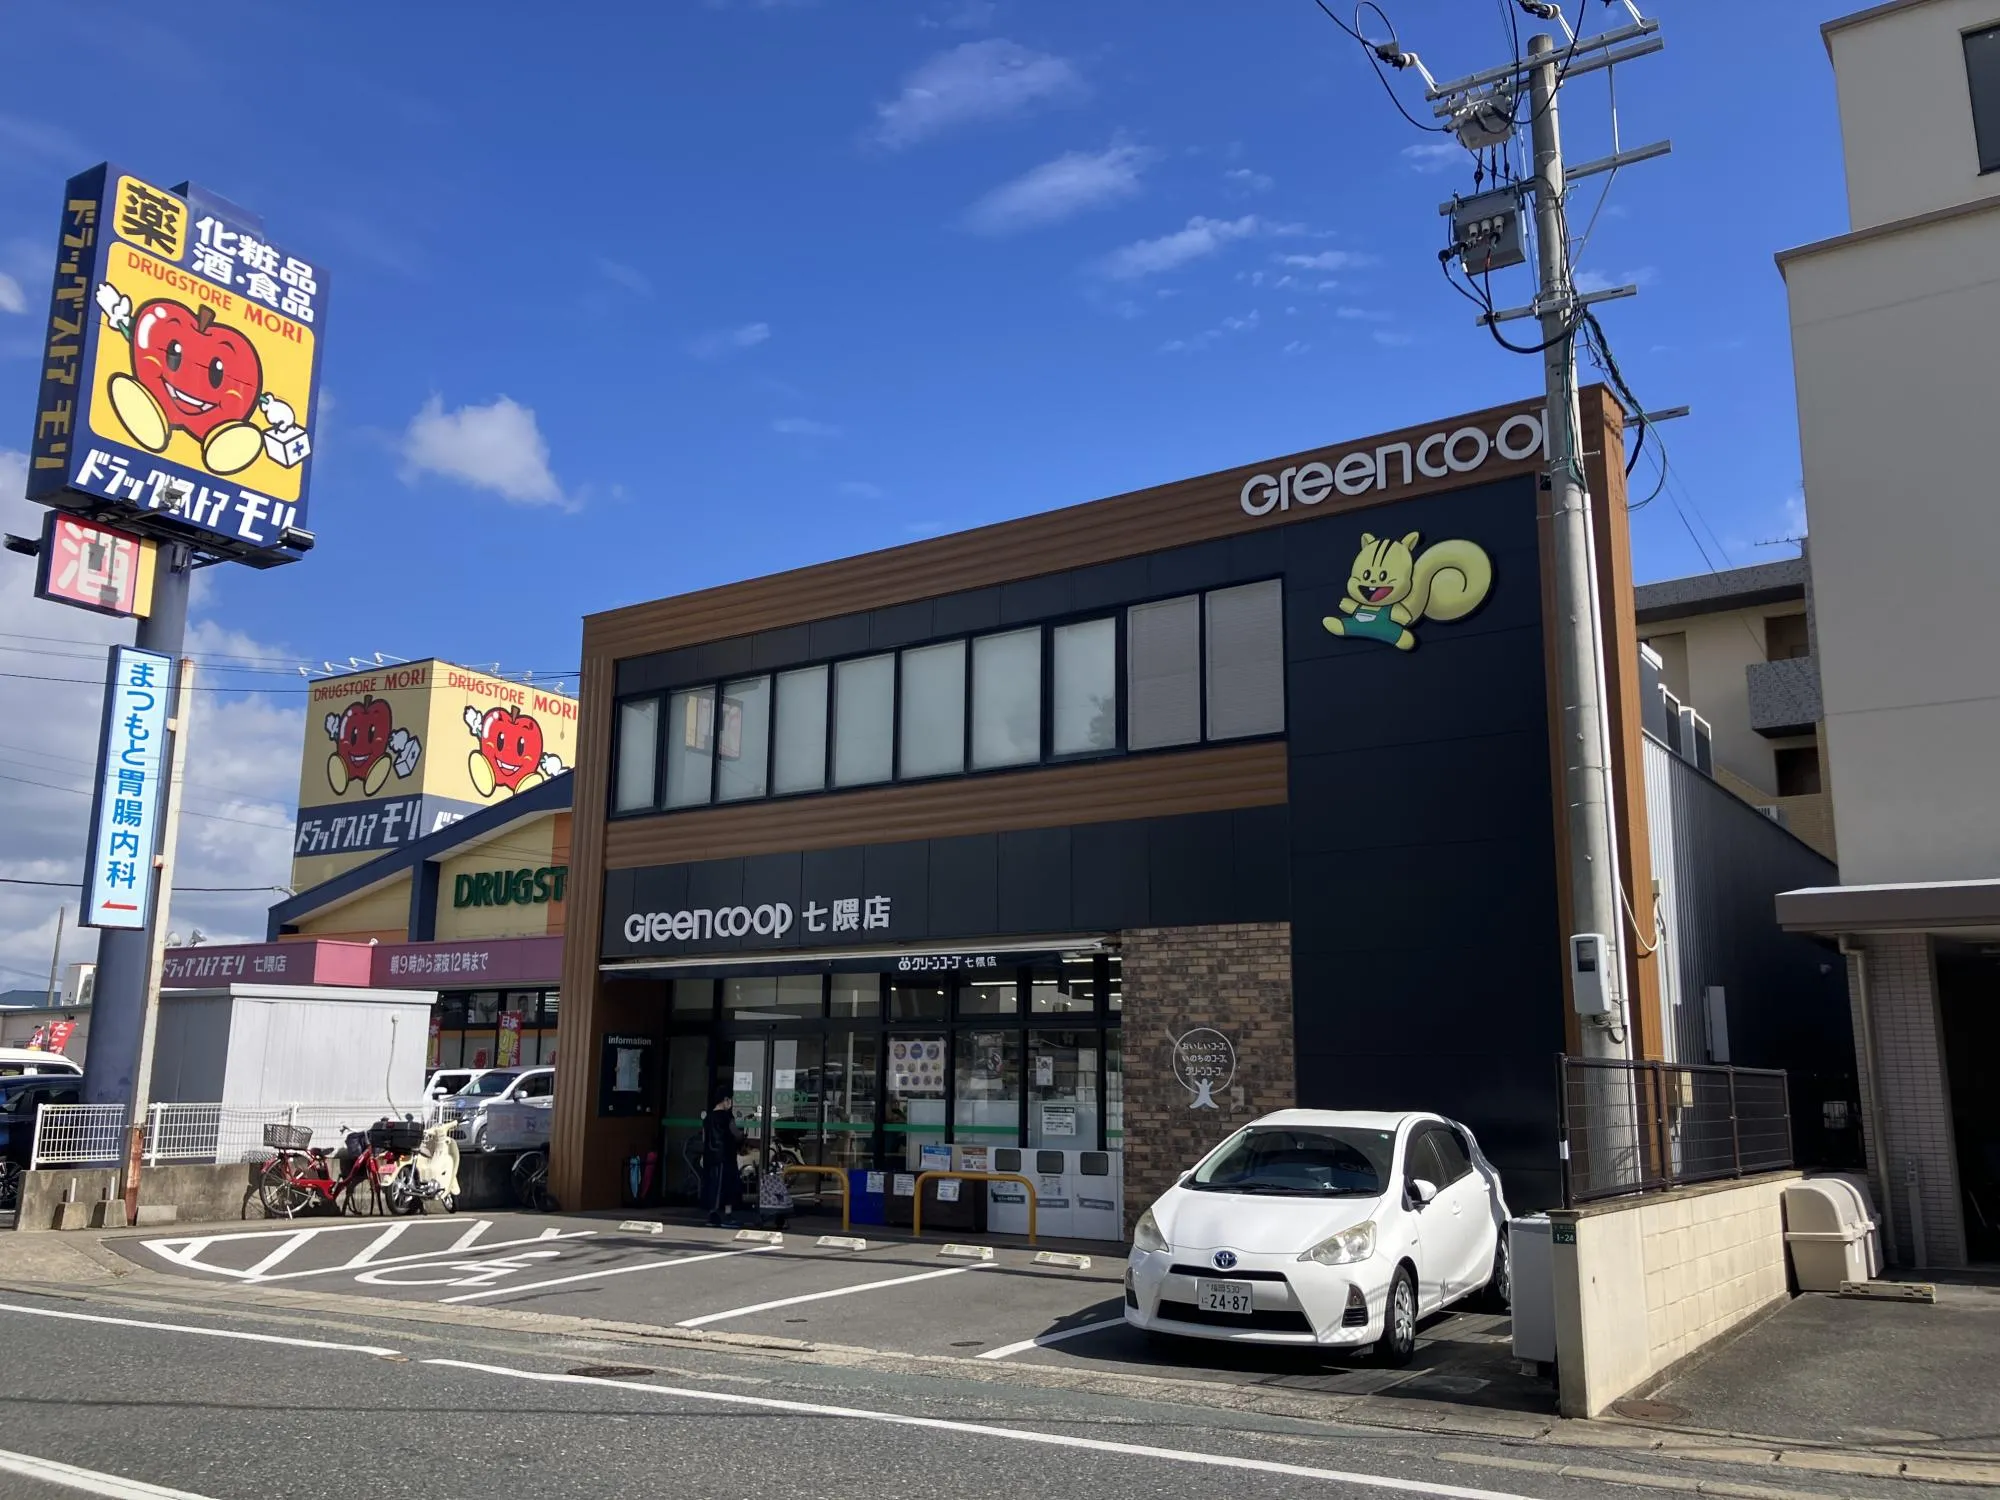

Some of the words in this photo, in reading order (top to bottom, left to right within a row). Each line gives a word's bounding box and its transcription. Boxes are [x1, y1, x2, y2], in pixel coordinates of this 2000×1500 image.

[121, 182, 180, 255] 薬
[195, 216, 317, 295] 化粧品
[128, 252, 232, 312] DRUGSTORE
[244, 303, 303, 343] MORI
[57, 522, 132, 604] 酒
[314, 678, 377, 702] DRUGSTORE
[384, 667, 427, 691] MORI
[448, 672, 525, 705] DRUGSTORE
[533, 695, 577, 721] MORI
[106, 662, 155, 890] まつもと胃腸内科
[802, 895, 892, 933] 七隈店
[1210, 1293, 1249, 1312] 24-87
